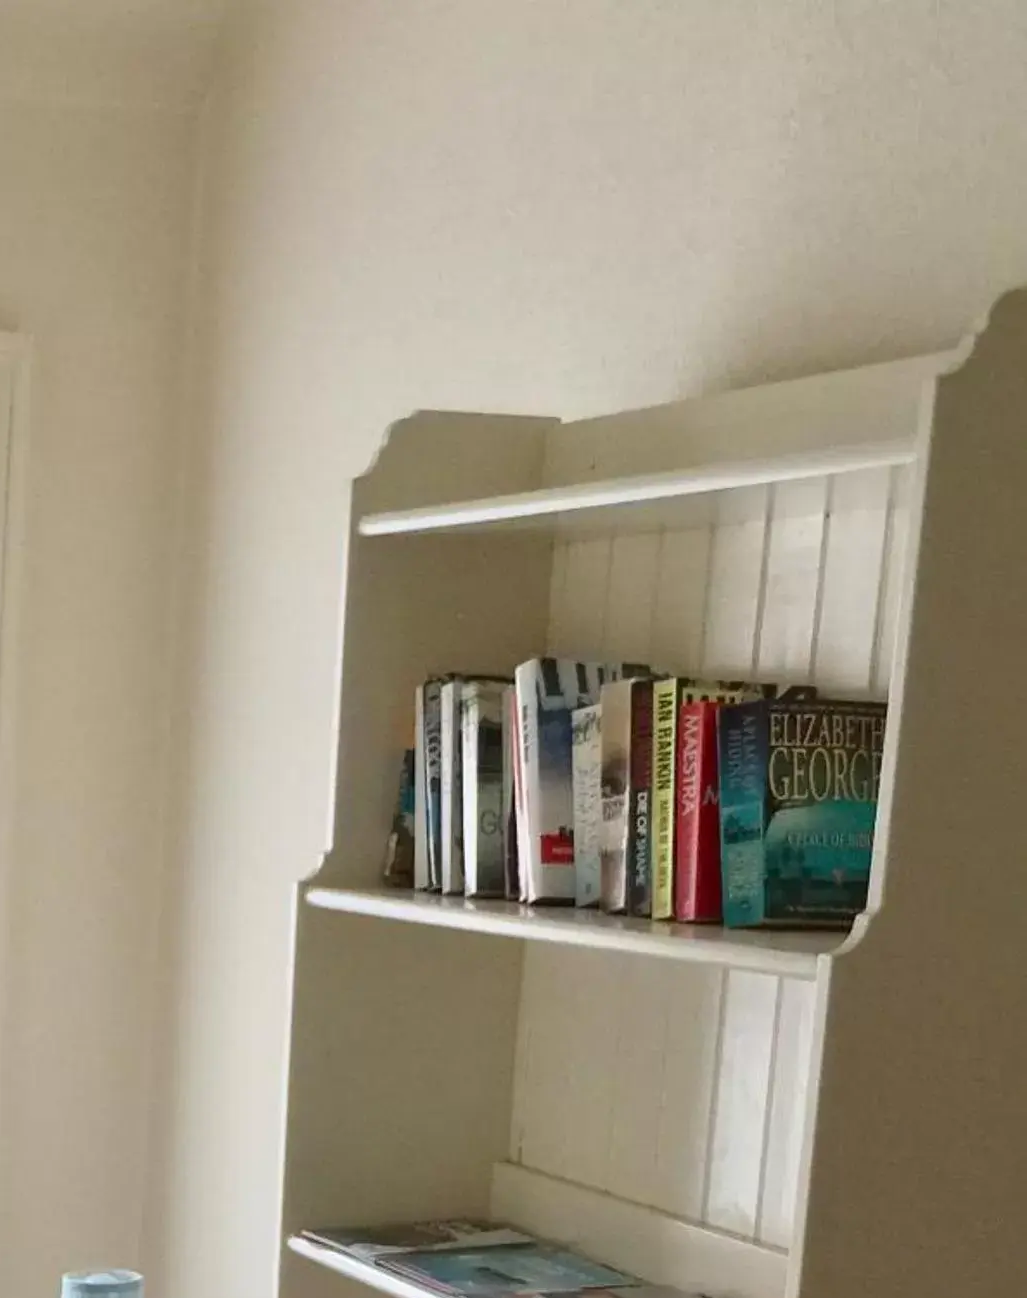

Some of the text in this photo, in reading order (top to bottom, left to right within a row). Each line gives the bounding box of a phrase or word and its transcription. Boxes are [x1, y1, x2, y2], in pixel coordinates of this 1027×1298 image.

[656, 692, 673, 791] IAN RANKIN
[768, 712, 887, 750] ELIZABETH
[682, 714, 701, 817] MAESTRA
[636, 791, 649, 815] DIE
[636, 815, 649, 836] OF
[634, 837, 648, 887] SHAME
